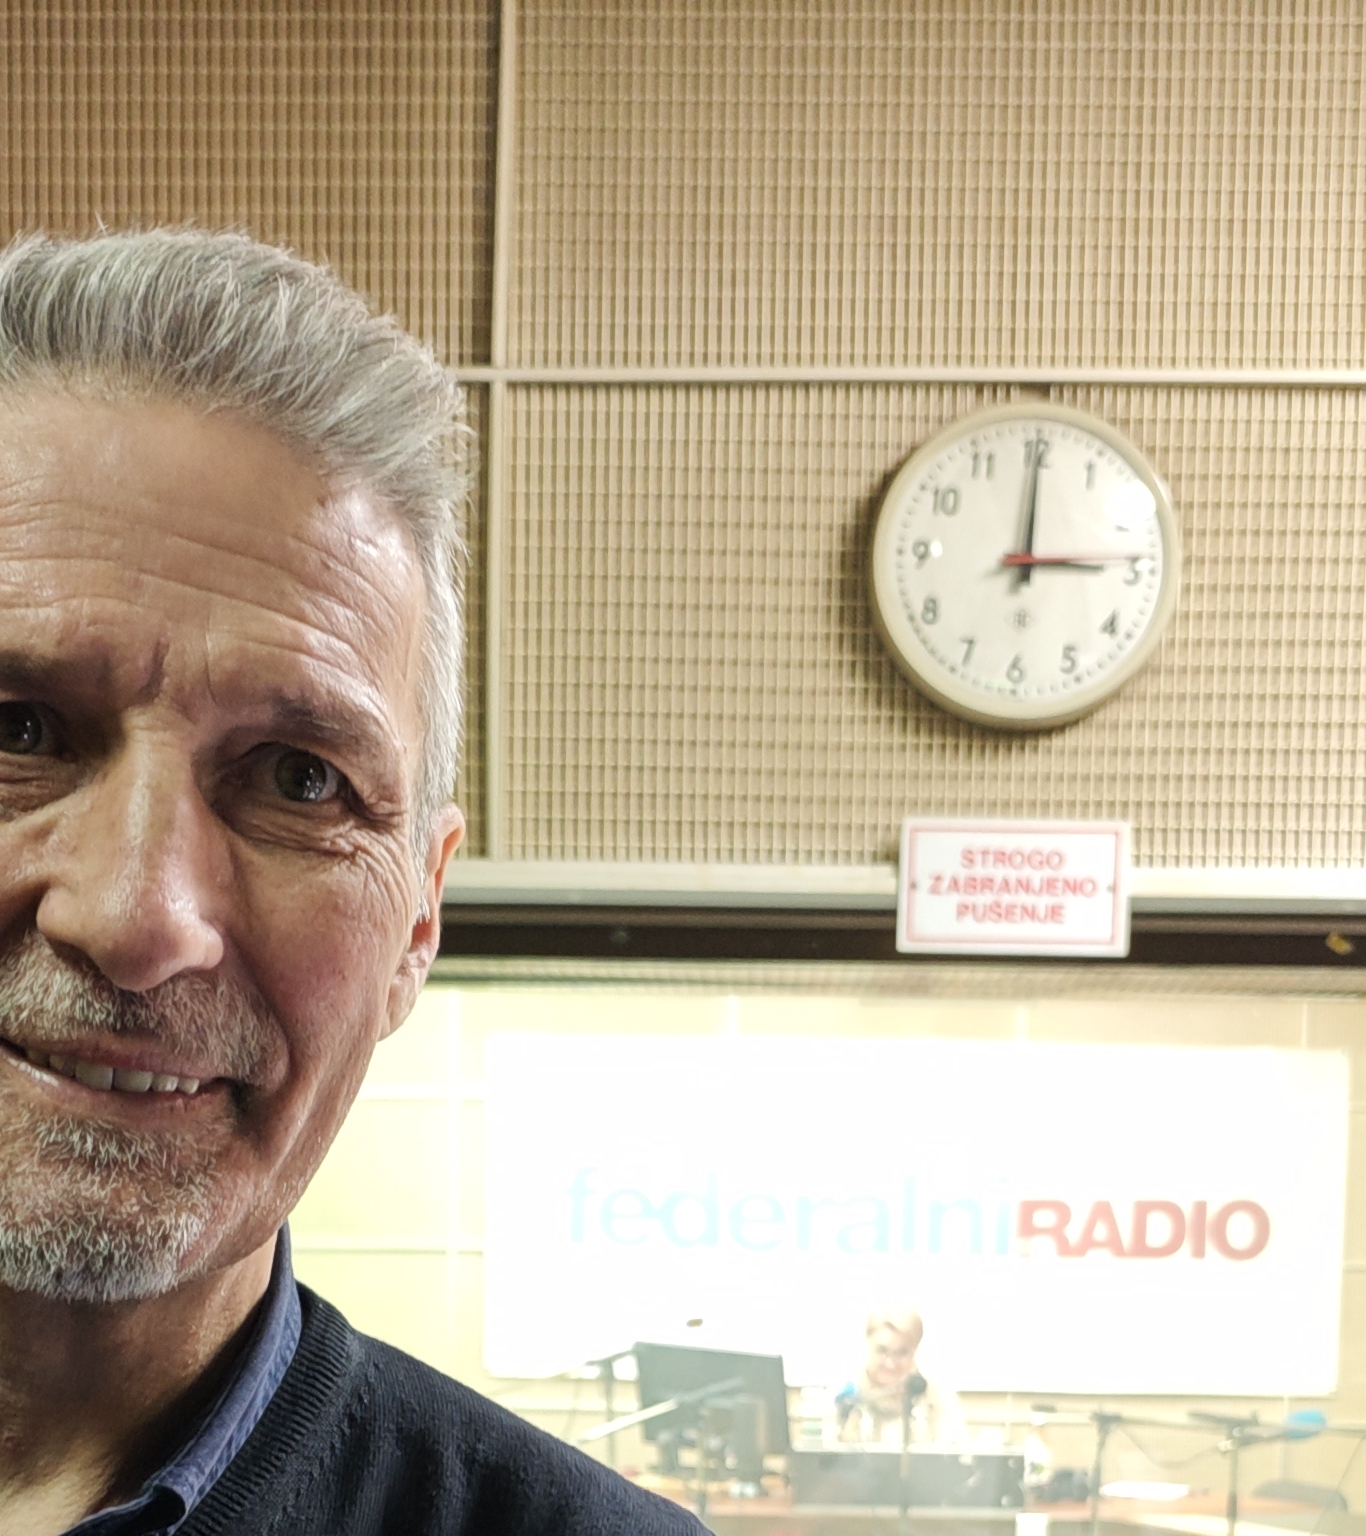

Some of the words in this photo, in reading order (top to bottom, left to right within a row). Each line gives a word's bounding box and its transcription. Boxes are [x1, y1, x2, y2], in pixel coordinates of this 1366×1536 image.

[970, 449, 996, 481] 11
[1085, 459, 1098, 491] 1
[932, 486, 960, 518] 10
[911, 539, 931, 571] 9
[921, 597, 940, 627] 8
[1099, 608, 1122, 640] 4
[959, 635, 977, 668] 7
[1059, 645, 1079, 676] 5
[1006, 654, 1026, 686] 6
[960, 847, 1066, 871] STROGO
[928, 873, 1098, 898] ZABRANJENO
[955, 900, 1065, 925] PUŠENJE
